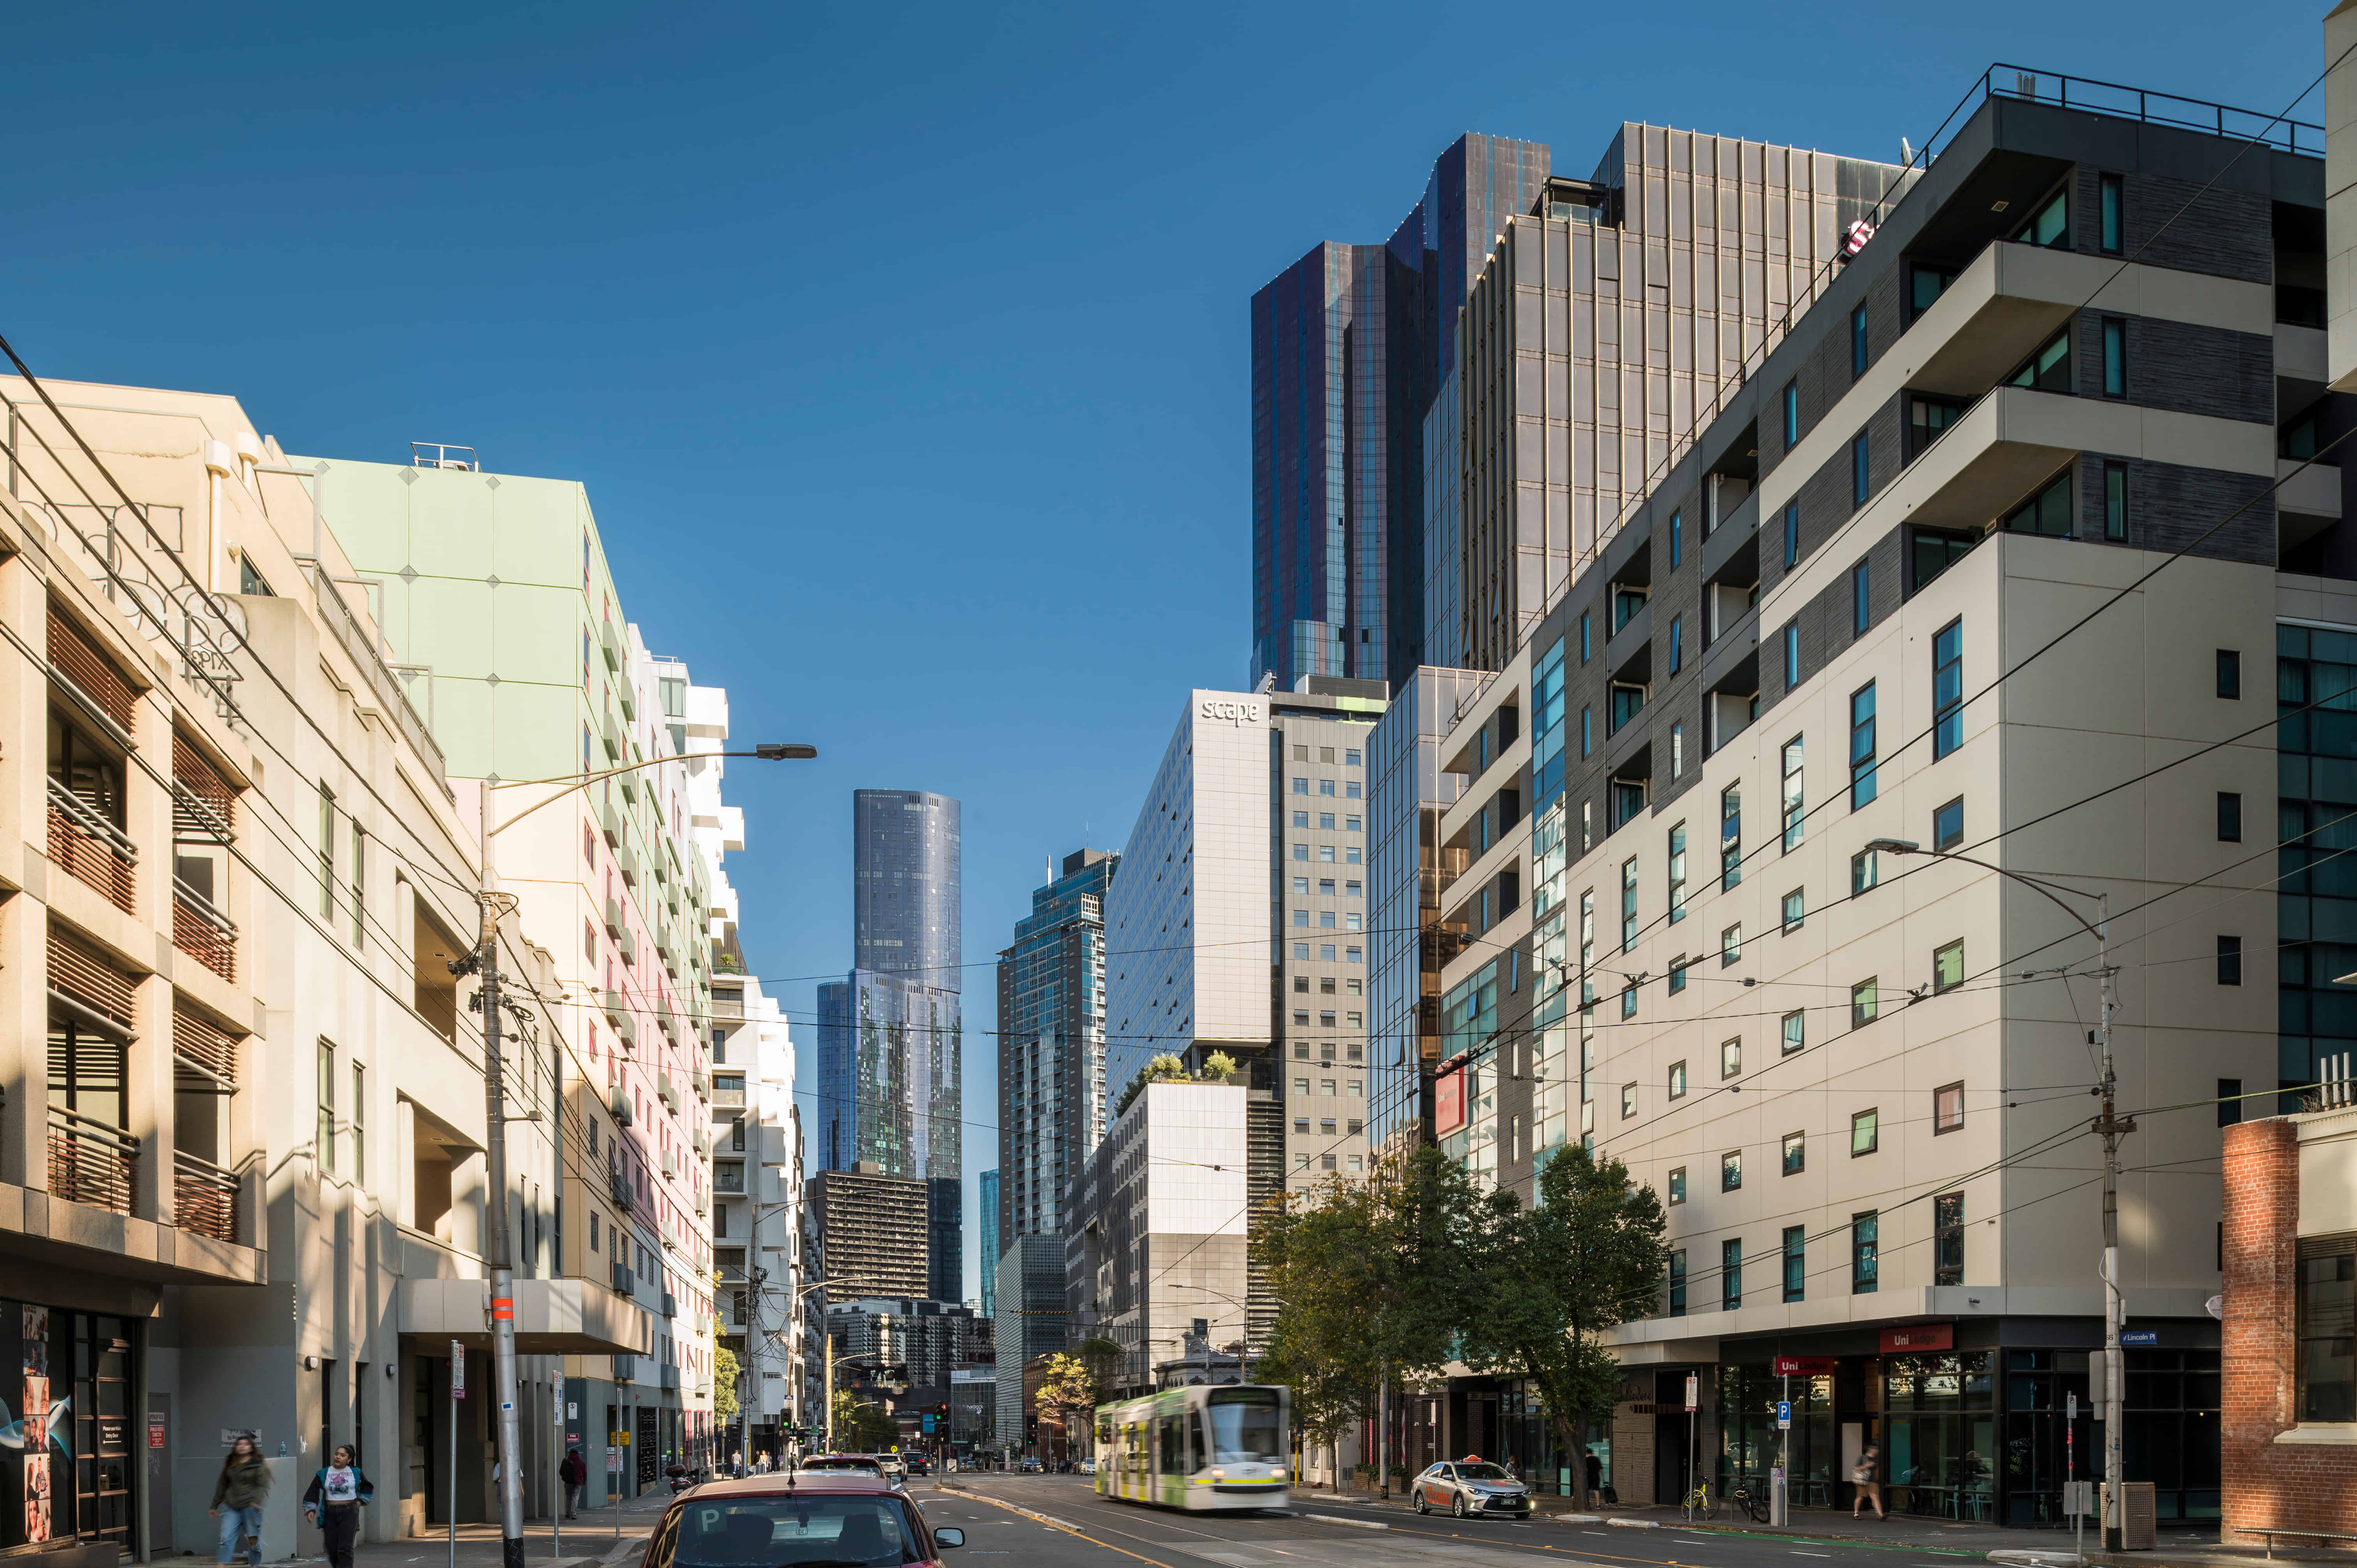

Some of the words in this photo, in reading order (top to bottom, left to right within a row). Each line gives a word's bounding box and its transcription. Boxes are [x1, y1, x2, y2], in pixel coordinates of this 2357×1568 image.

[1202, 700, 1260, 727] scape
[1894, 1334, 1936, 1346] UniLodge
[1782, 1362, 1827, 1371] UniLodge
[1781, 1405, 1787, 1418] P
[1426, 1486, 1451, 1506] 13cabs
[701, 1509, 719, 1531] P
